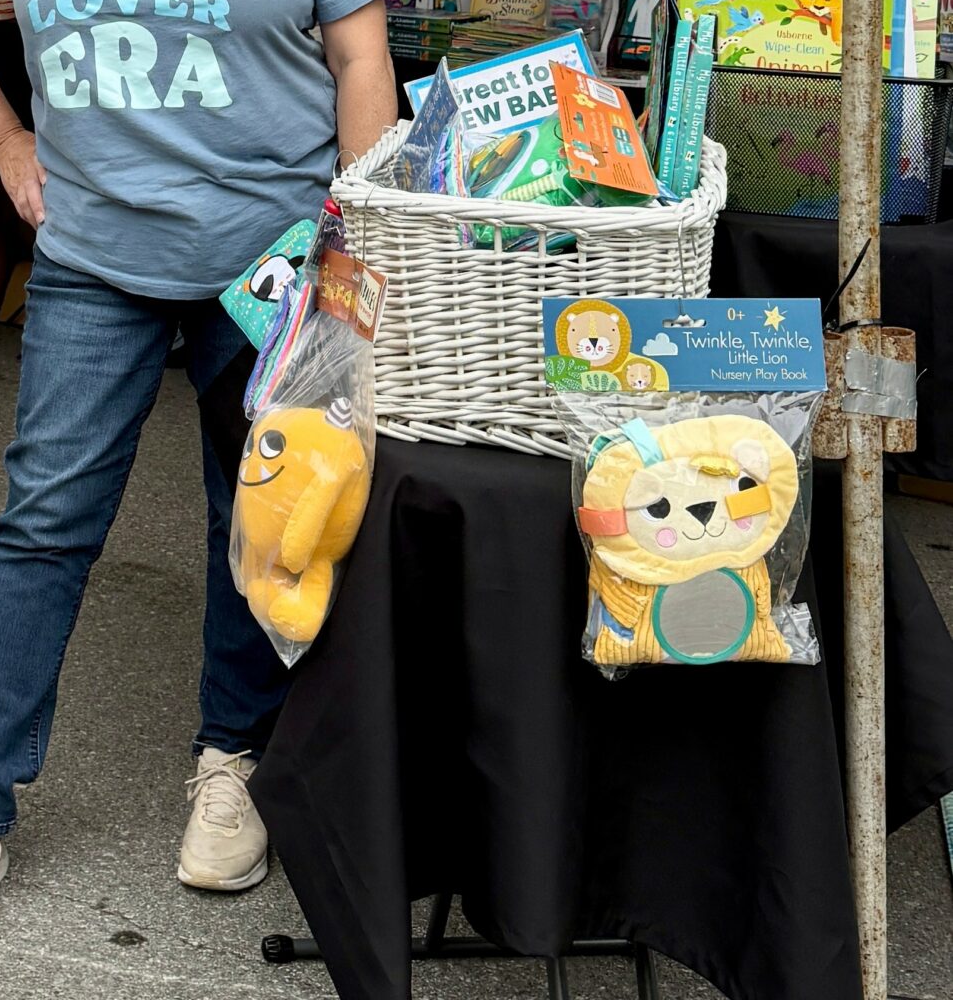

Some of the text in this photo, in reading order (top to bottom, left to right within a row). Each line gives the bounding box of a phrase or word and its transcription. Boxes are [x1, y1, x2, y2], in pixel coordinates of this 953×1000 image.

[776, 30, 813, 42] Usborne
[765, 40, 825, 56] Wipe-Clean
[40, 21, 233, 109] ERA
[668, 35, 690, 113] My Little Library
[690, 69, 711, 147] My Little Library
[727, 307, 746, 321] 0+
[682, 331, 814, 352] Twinkle, Twinkle,
[728, 350, 788, 365] Little Lion
[710, 368, 808, 382] Nursery Play Book
